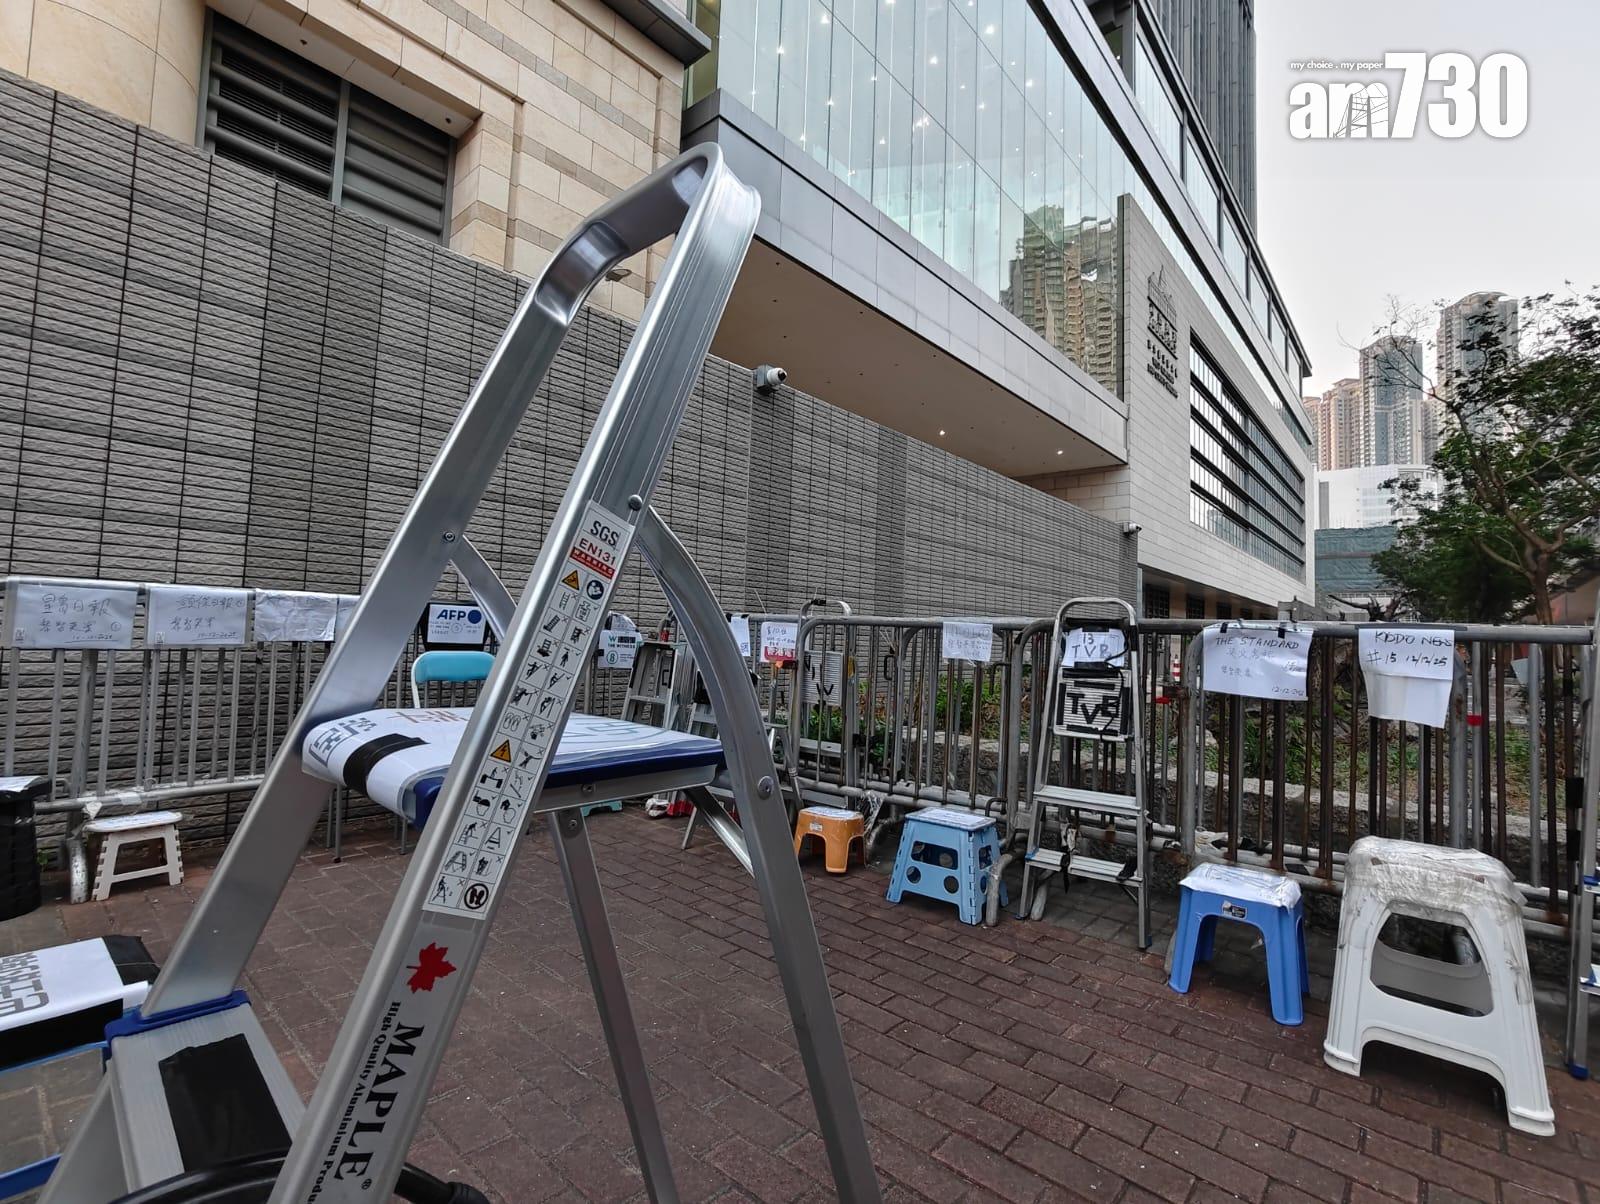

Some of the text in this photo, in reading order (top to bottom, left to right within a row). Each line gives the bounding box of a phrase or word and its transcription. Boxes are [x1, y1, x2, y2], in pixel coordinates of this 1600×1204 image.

[590, 520, 620, 546] SGS
[573, 549, 615, 576] WARNING
[579, 537, 617, 566] EN131
[436, 609, 467, 621] AFP
[1215, 636, 1299, 650] THE STANDARD
[1066, 692, 1121, 725] TVB
[382, 1001, 402, 1032] High
[359, 1033, 387, 1082] Quality
[333, 1022, 425, 1181] MAPLE
[327, 1083, 366, 1157] Aluminium
